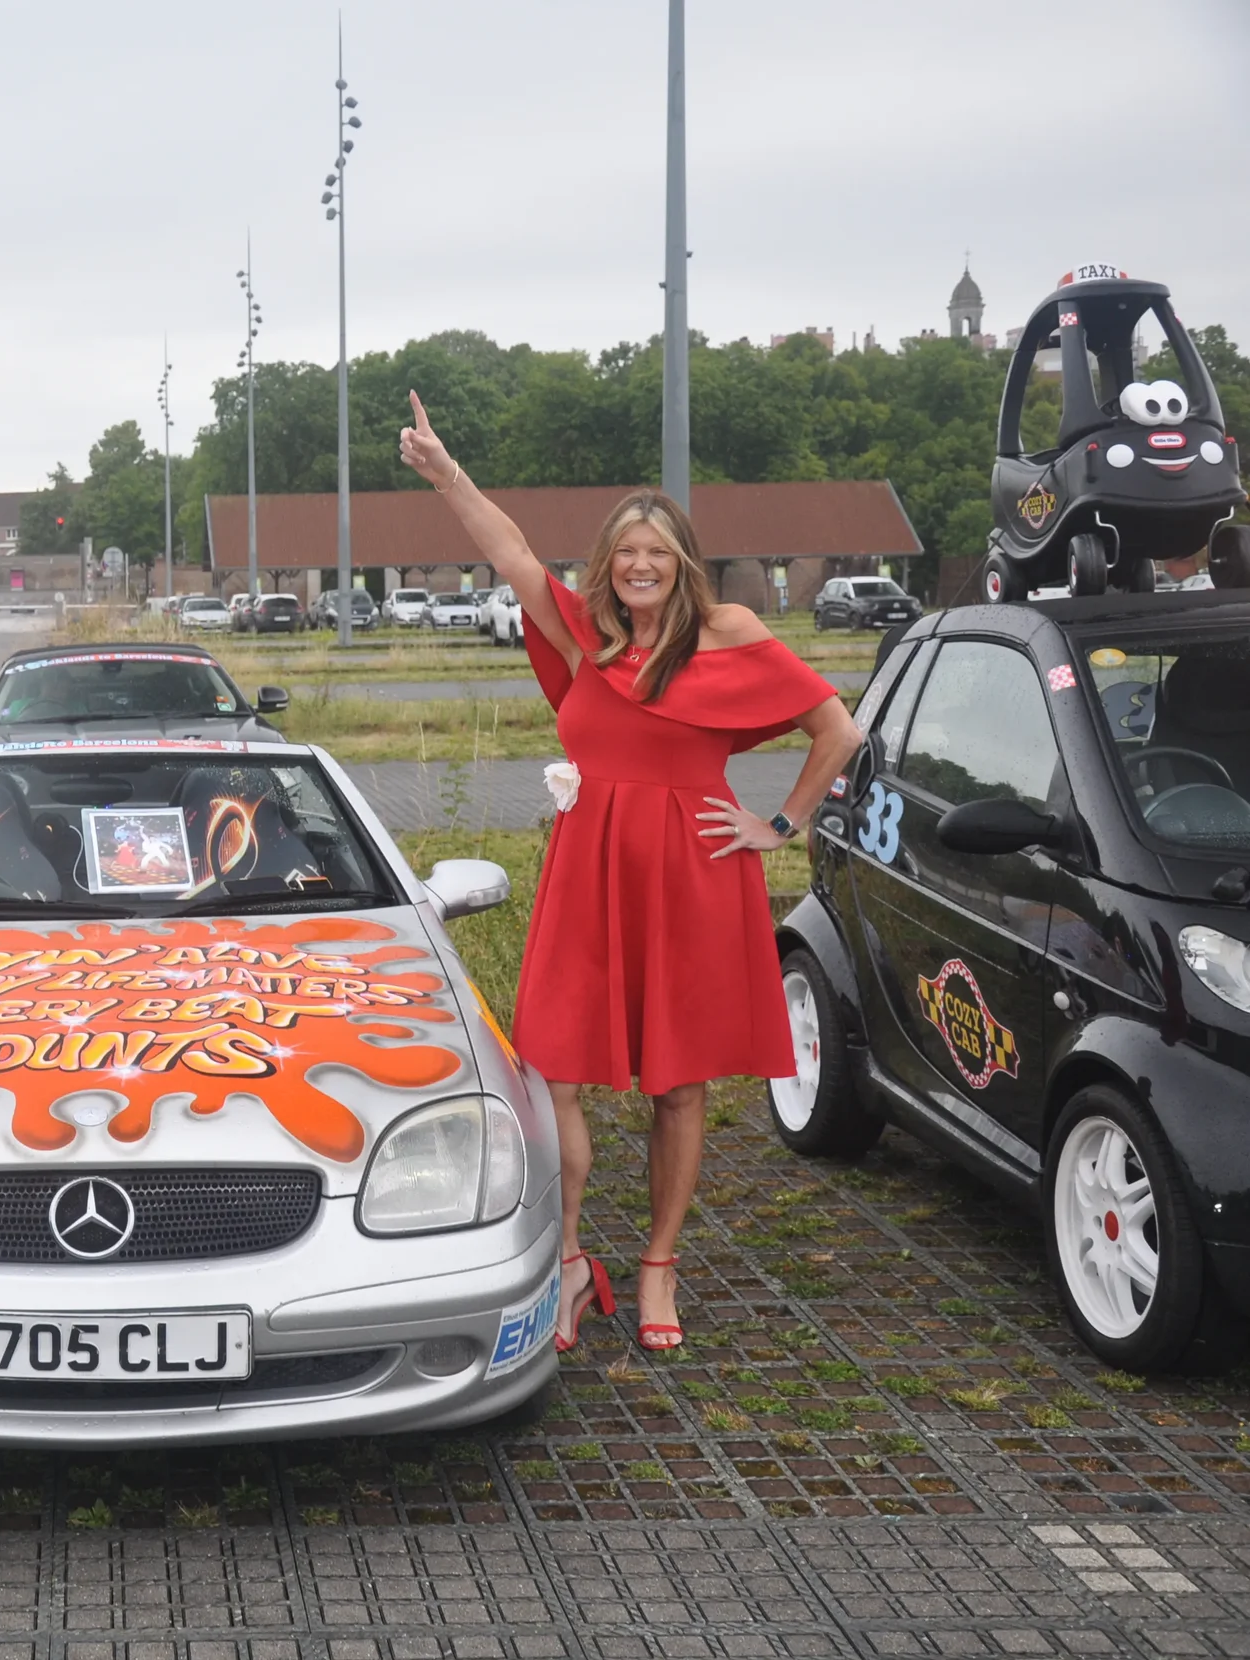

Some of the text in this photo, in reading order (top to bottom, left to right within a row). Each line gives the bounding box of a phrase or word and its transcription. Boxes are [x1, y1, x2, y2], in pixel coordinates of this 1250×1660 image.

[1078, 264, 1117, 279] TAXI
[72, 739, 159, 747] Barcelona
[858, 781, 904, 864] 33
[153, 944, 370, 976] ALIVE
[35, 968, 171, 992] LIFE
[174, 966, 431, 1006] MATTERS
[117, 992, 350, 1029] BEAT
[945, 992, 981, 1033] COZY
[951, 1021, 981, 1058] CAB
[119, 1322, 227, 1372] CLJ
